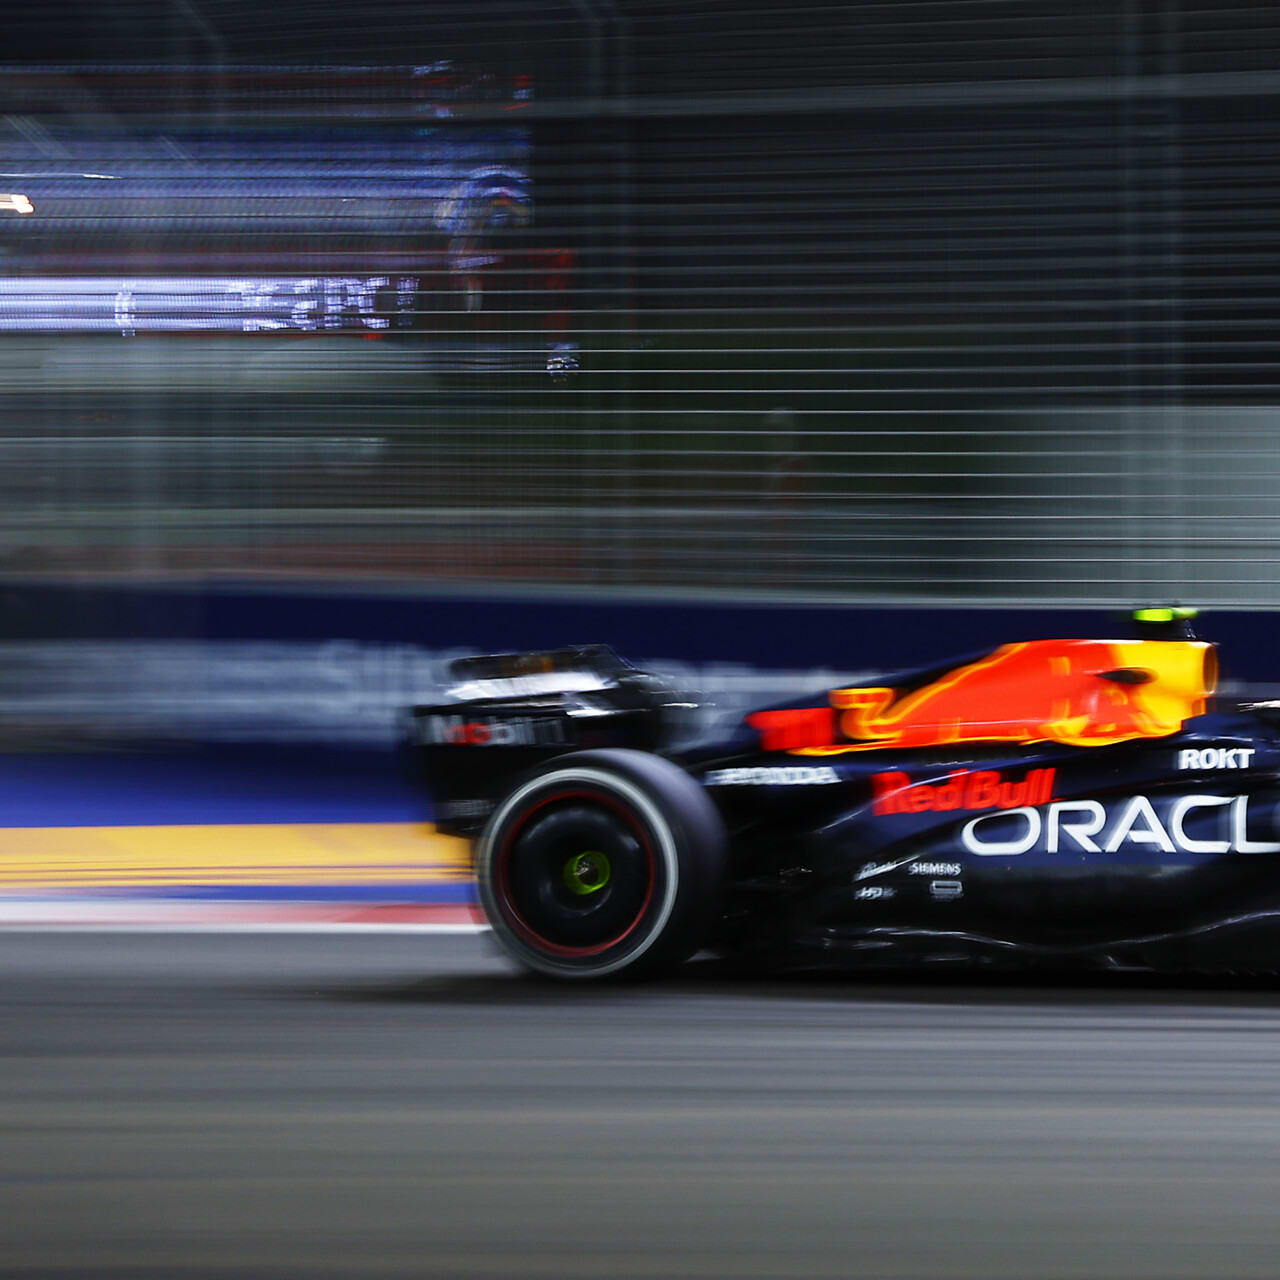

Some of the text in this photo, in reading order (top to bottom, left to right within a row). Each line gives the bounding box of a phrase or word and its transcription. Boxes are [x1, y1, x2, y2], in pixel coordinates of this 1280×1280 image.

[1179, 748, 1255, 769] ROKT
[872, 768, 1056, 816] Red Bull
[908, 862, 961, 875] SIEMENS
